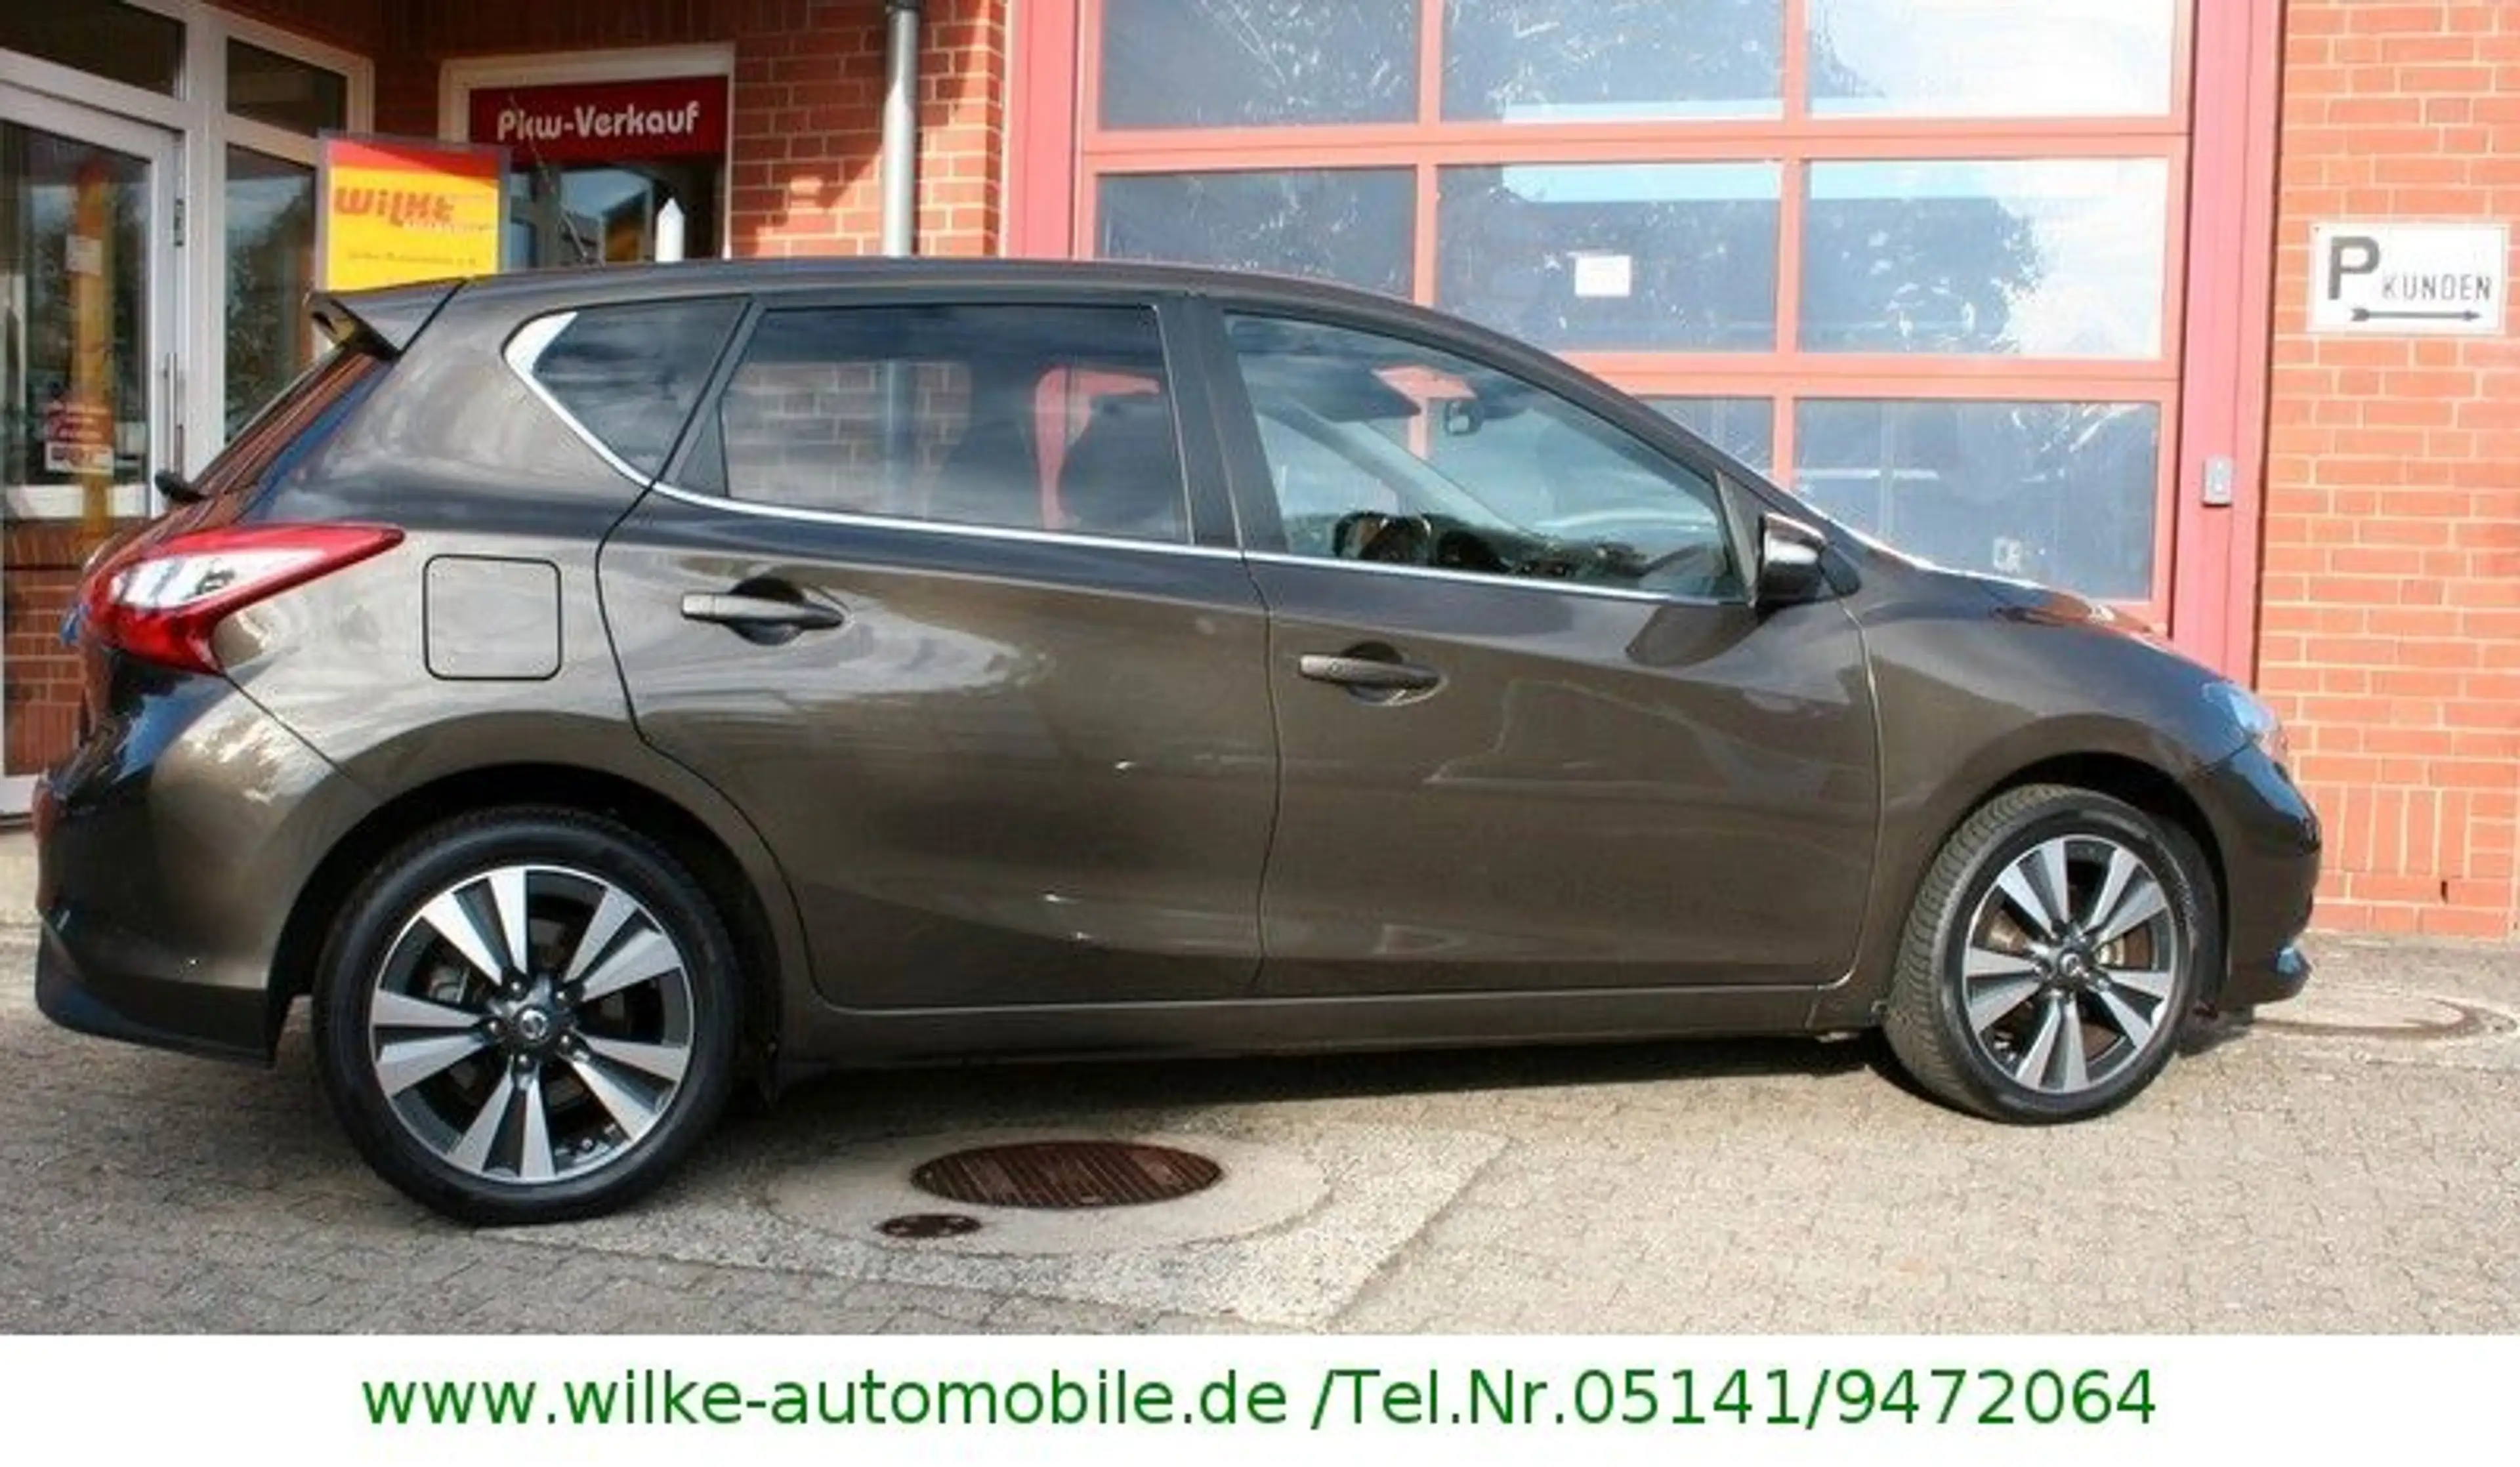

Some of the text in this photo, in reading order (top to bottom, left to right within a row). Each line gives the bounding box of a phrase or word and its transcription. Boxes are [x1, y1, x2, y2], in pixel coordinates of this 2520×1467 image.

[497, 100, 700, 141] Pkw-Verkauf
[2327, 236, 2492, 300] P KUNDEN
